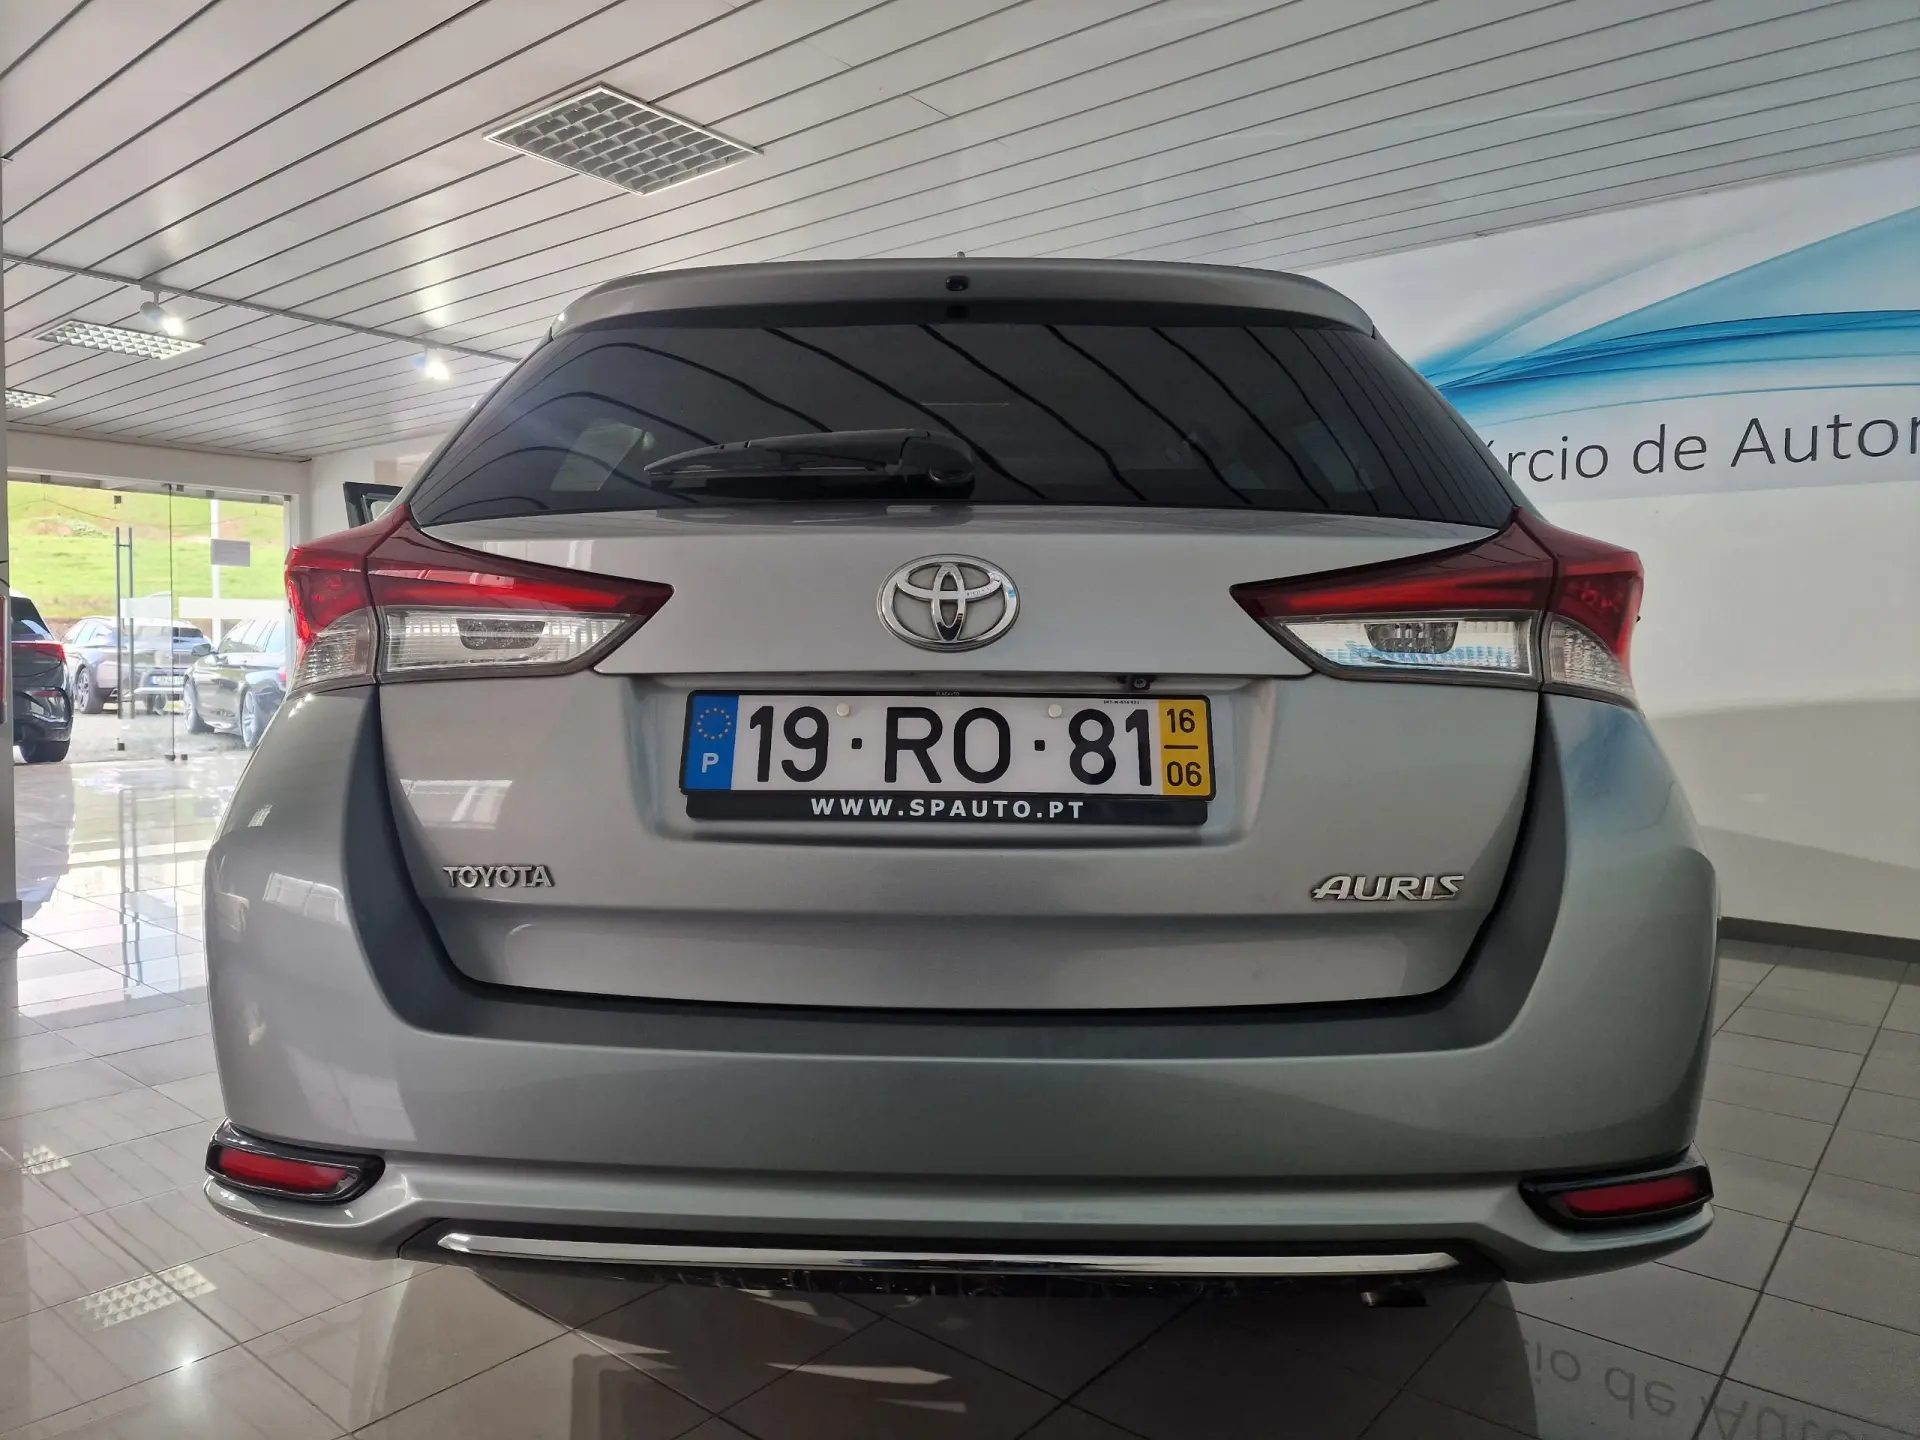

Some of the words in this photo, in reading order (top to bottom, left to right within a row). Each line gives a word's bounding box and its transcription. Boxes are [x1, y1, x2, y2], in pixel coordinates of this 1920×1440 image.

[1487, 435, 1609, 482] rcio
[1632, 423, 1707, 474] de
[1166, 708, 1196, 734] 16
[701, 752, 719, 773] P
[1166, 761, 1203, 787] 06
[810, 797, 1084, 819] WWW.SPAUTO.PT
[442, 865, 554, 888] TOYOTA
[1312, 875, 1465, 901] AURIS
